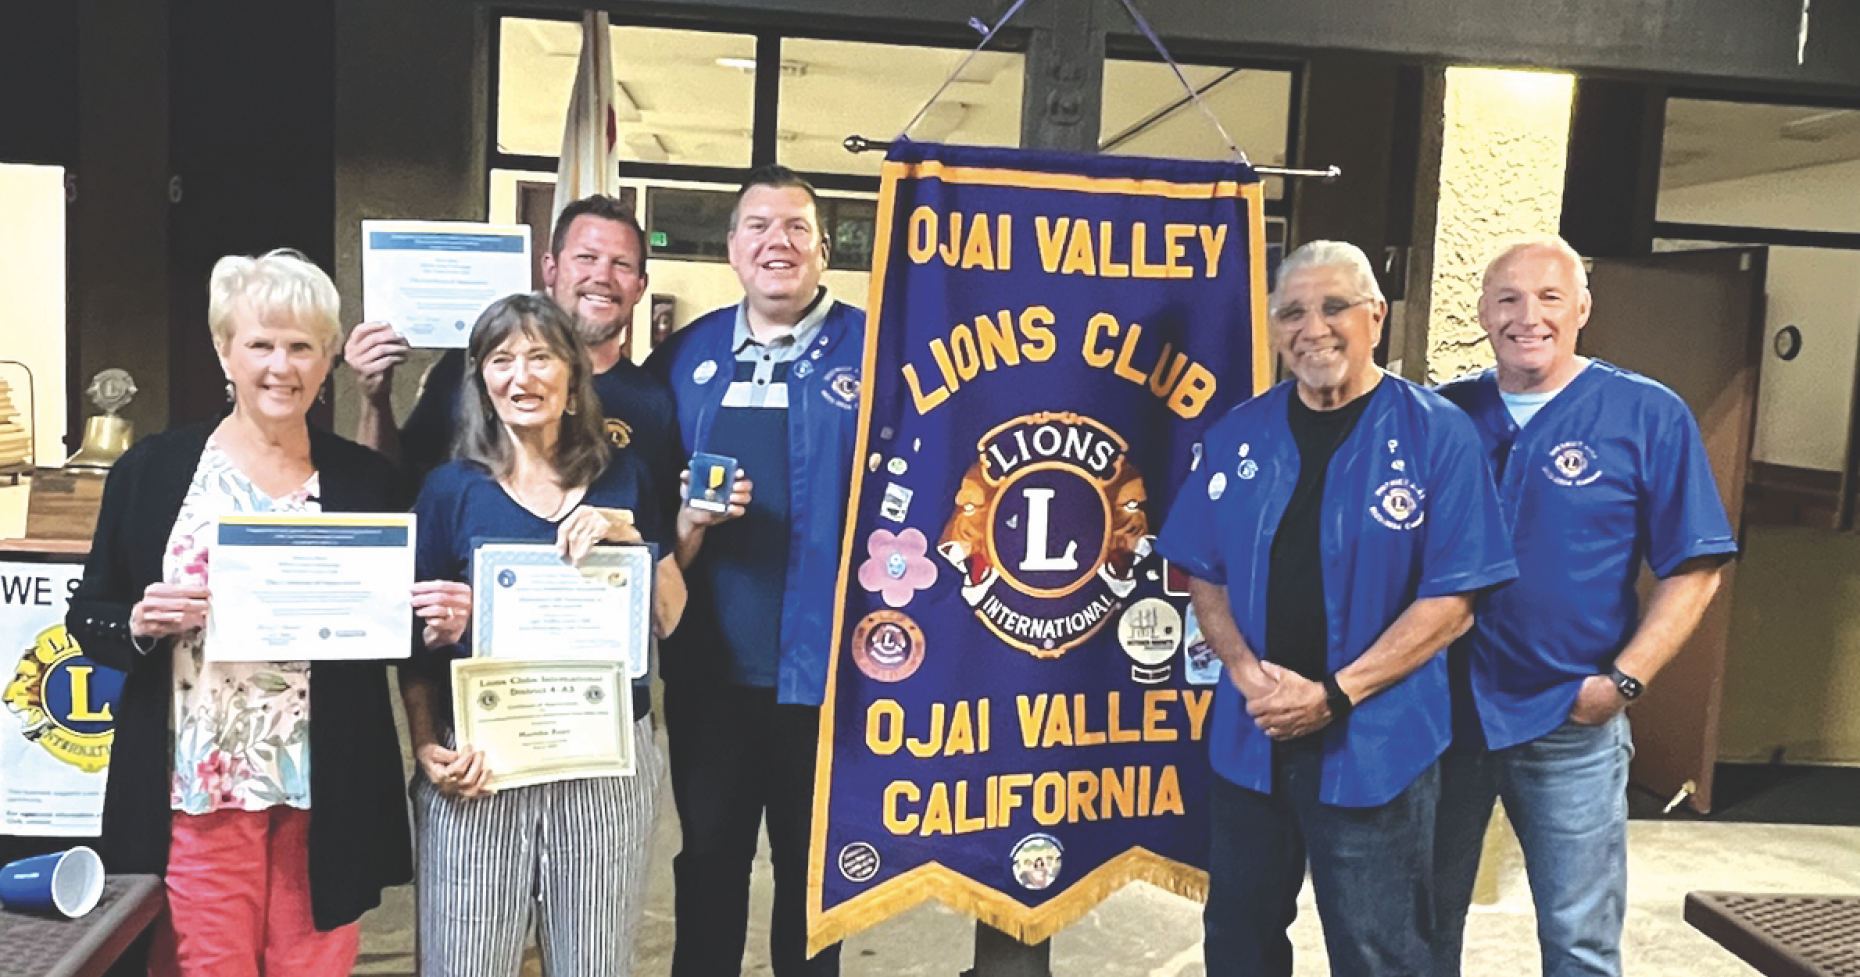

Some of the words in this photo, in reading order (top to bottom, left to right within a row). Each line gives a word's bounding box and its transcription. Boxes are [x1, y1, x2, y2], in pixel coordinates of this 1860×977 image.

[168, 175, 183, 203] 6
[908, 206, 1012, 271] OJAI
[1034, 216, 1228, 279] VALLEY
[901, 305, 1057, 416] LIONS
[1082, 312, 1217, 419] CLUB
[988, 425, 1115, 472] LIONS
[1018, 487, 1079, 571] L
[1, 575, 53, 606] WE
[982, 594, 1115, 639] INTERNATIONAL
[65, 666, 114, 722] L
[865, 698, 990, 758] OJAI
[1016, 689, 1213, 748] VALLEY
[882, 765, 1186, 837] CALIFORNIA
